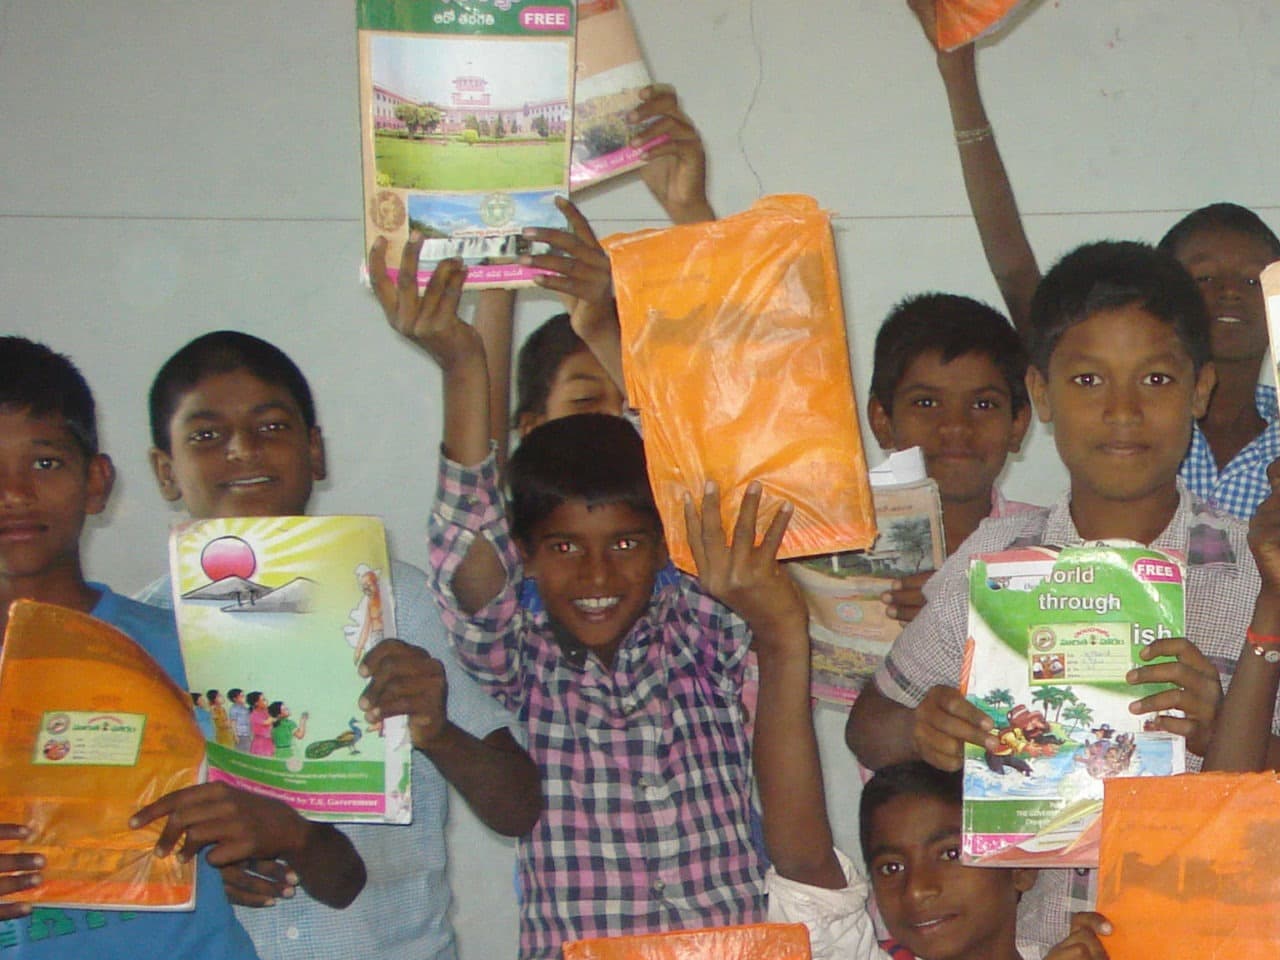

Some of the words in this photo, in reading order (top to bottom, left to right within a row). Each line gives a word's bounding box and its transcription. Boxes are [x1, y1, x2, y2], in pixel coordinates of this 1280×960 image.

[524, 12, 566, 25] FREE
[1136, 564, 1174, 577] FREE
[1039, 594, 1122, 615] through
